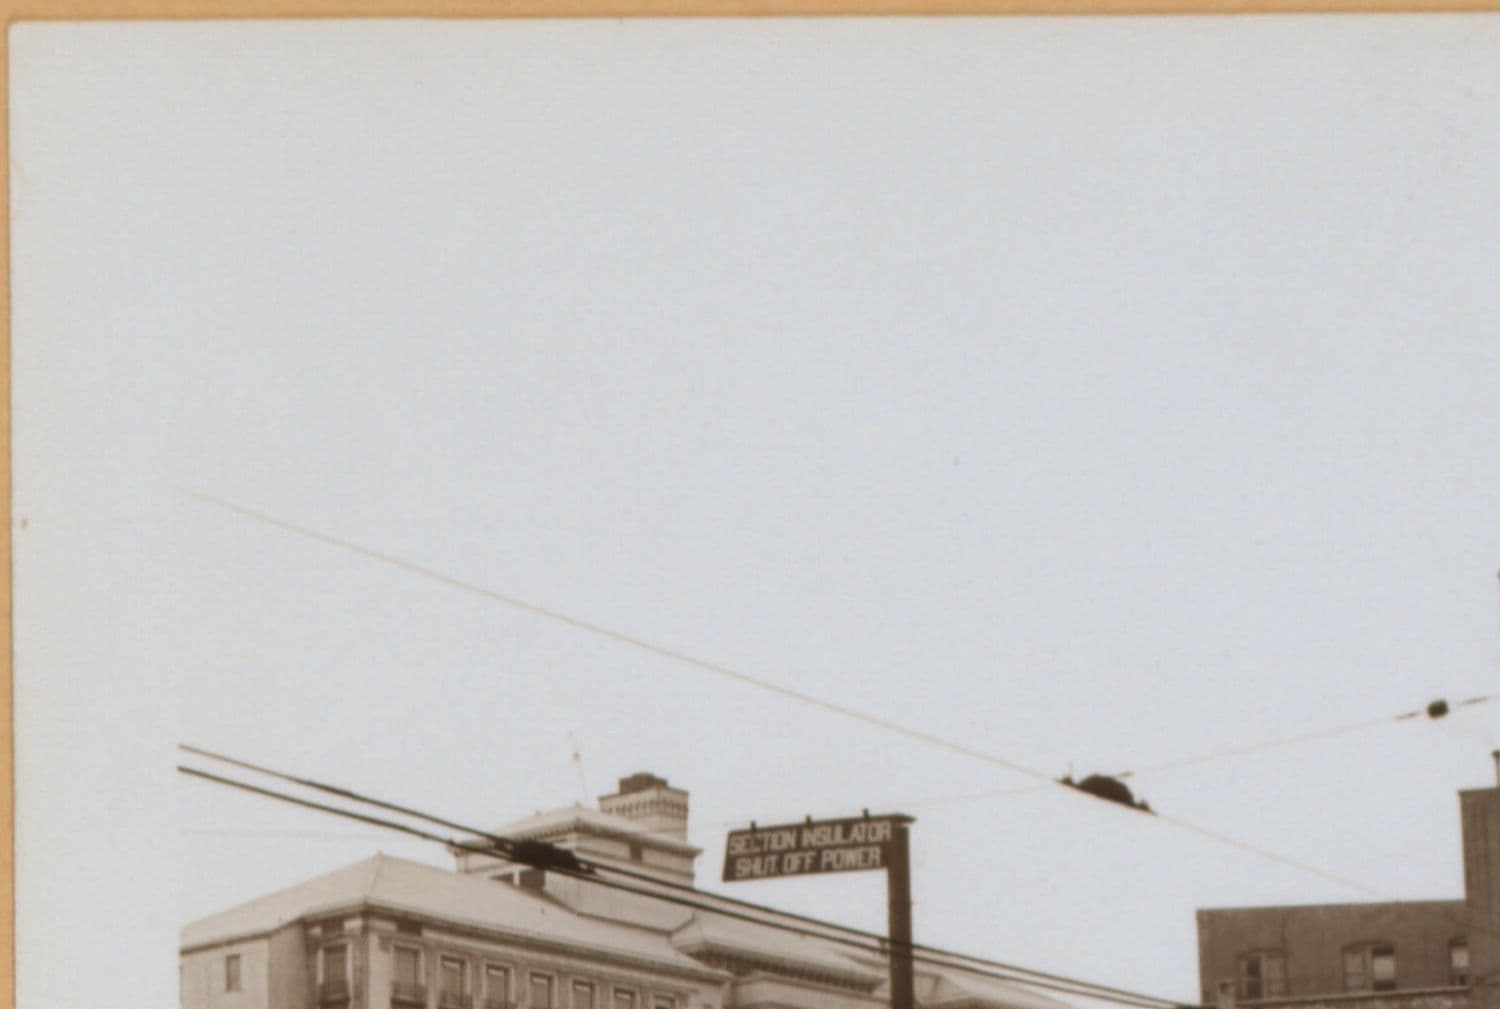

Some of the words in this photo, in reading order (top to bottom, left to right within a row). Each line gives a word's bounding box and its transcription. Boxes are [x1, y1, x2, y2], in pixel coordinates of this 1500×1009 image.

[729, 829, 797, 855] SECTION
[802, 820, 891, 848] INSULATOR
[735, 854, 778, 878] SHUT
[783, 851, 817, 874] OFF
[821, 846, 881, 870] POWER
